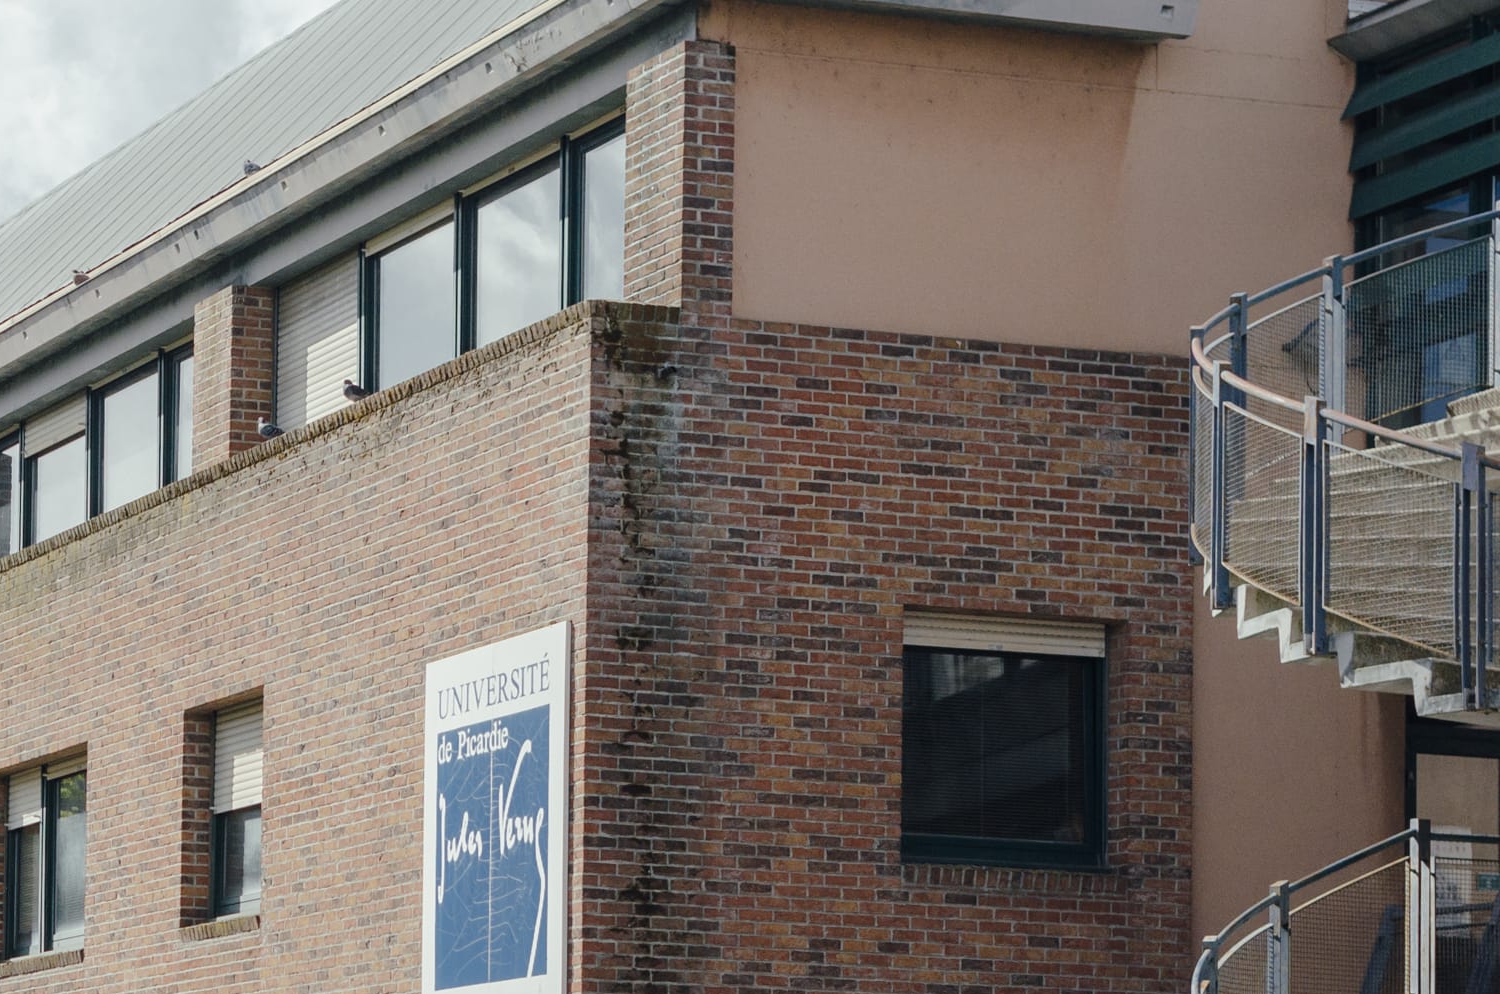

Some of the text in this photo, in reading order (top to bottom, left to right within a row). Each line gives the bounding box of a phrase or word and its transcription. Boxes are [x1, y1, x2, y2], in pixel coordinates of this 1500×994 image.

[438, 653, 550, 720] UNIVERSITÉ
[438, 720, 509, 765] de Picardie
[437, 739, 546, 978] Jules Verne
